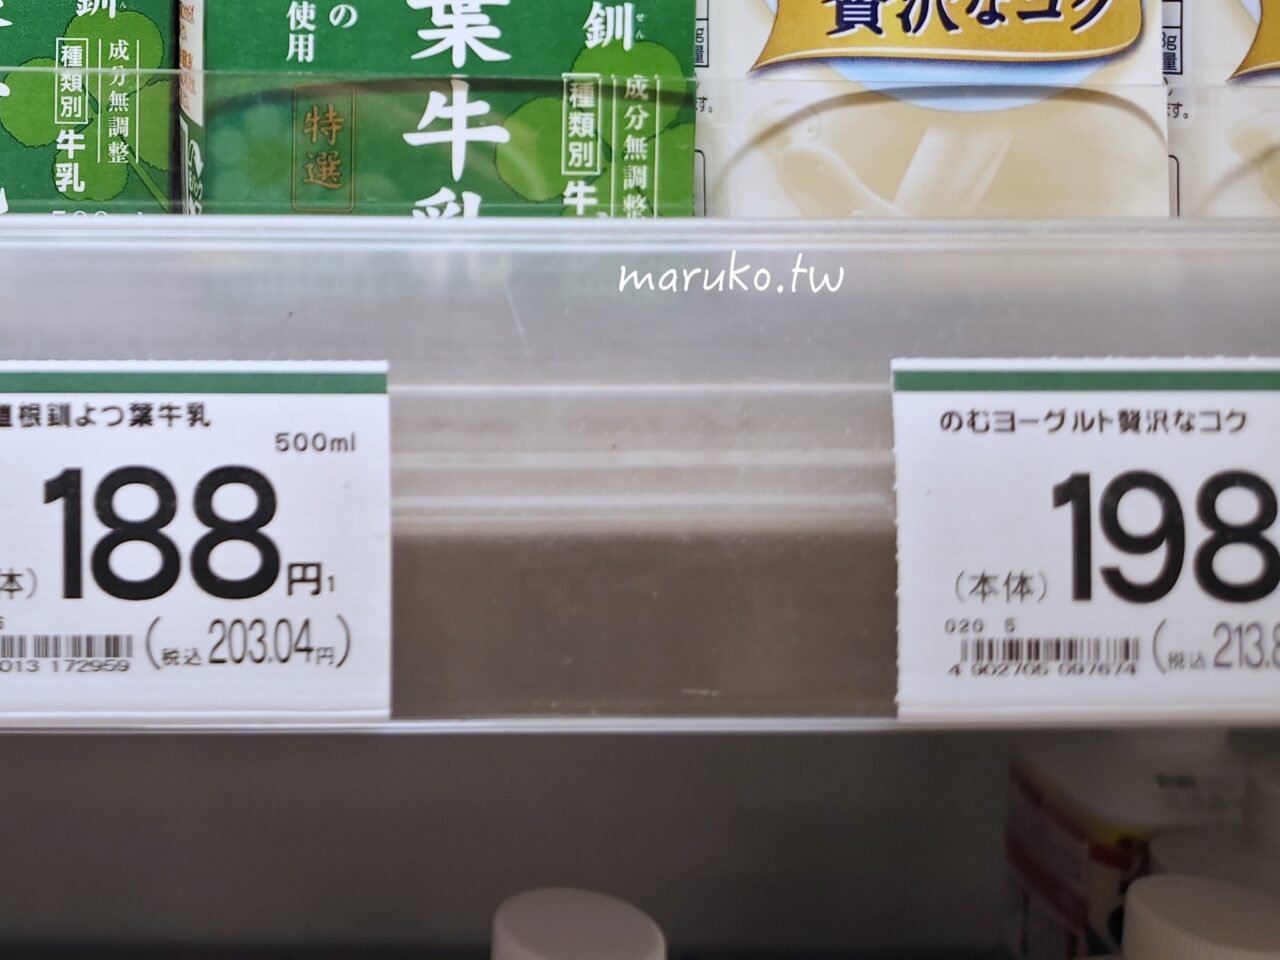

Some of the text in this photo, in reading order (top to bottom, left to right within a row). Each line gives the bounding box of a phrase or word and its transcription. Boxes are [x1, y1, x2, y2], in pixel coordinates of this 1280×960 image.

[60, 45, 83, 118] 種類別
[107, 38, 130, 164] 成分無調整
[56, 129, 86, 193] 牛乳
[302, 104, 345, 190] 特選
[568, 82, 596, 168] 種類別
[563, 180, 598, 217] 牛
[275, 433, 357, 453] 500ml
[939, 408, 1247, 434] のむヨーグルト贅沢なコク
[955, 469, 1280, 604] (本体) 198
